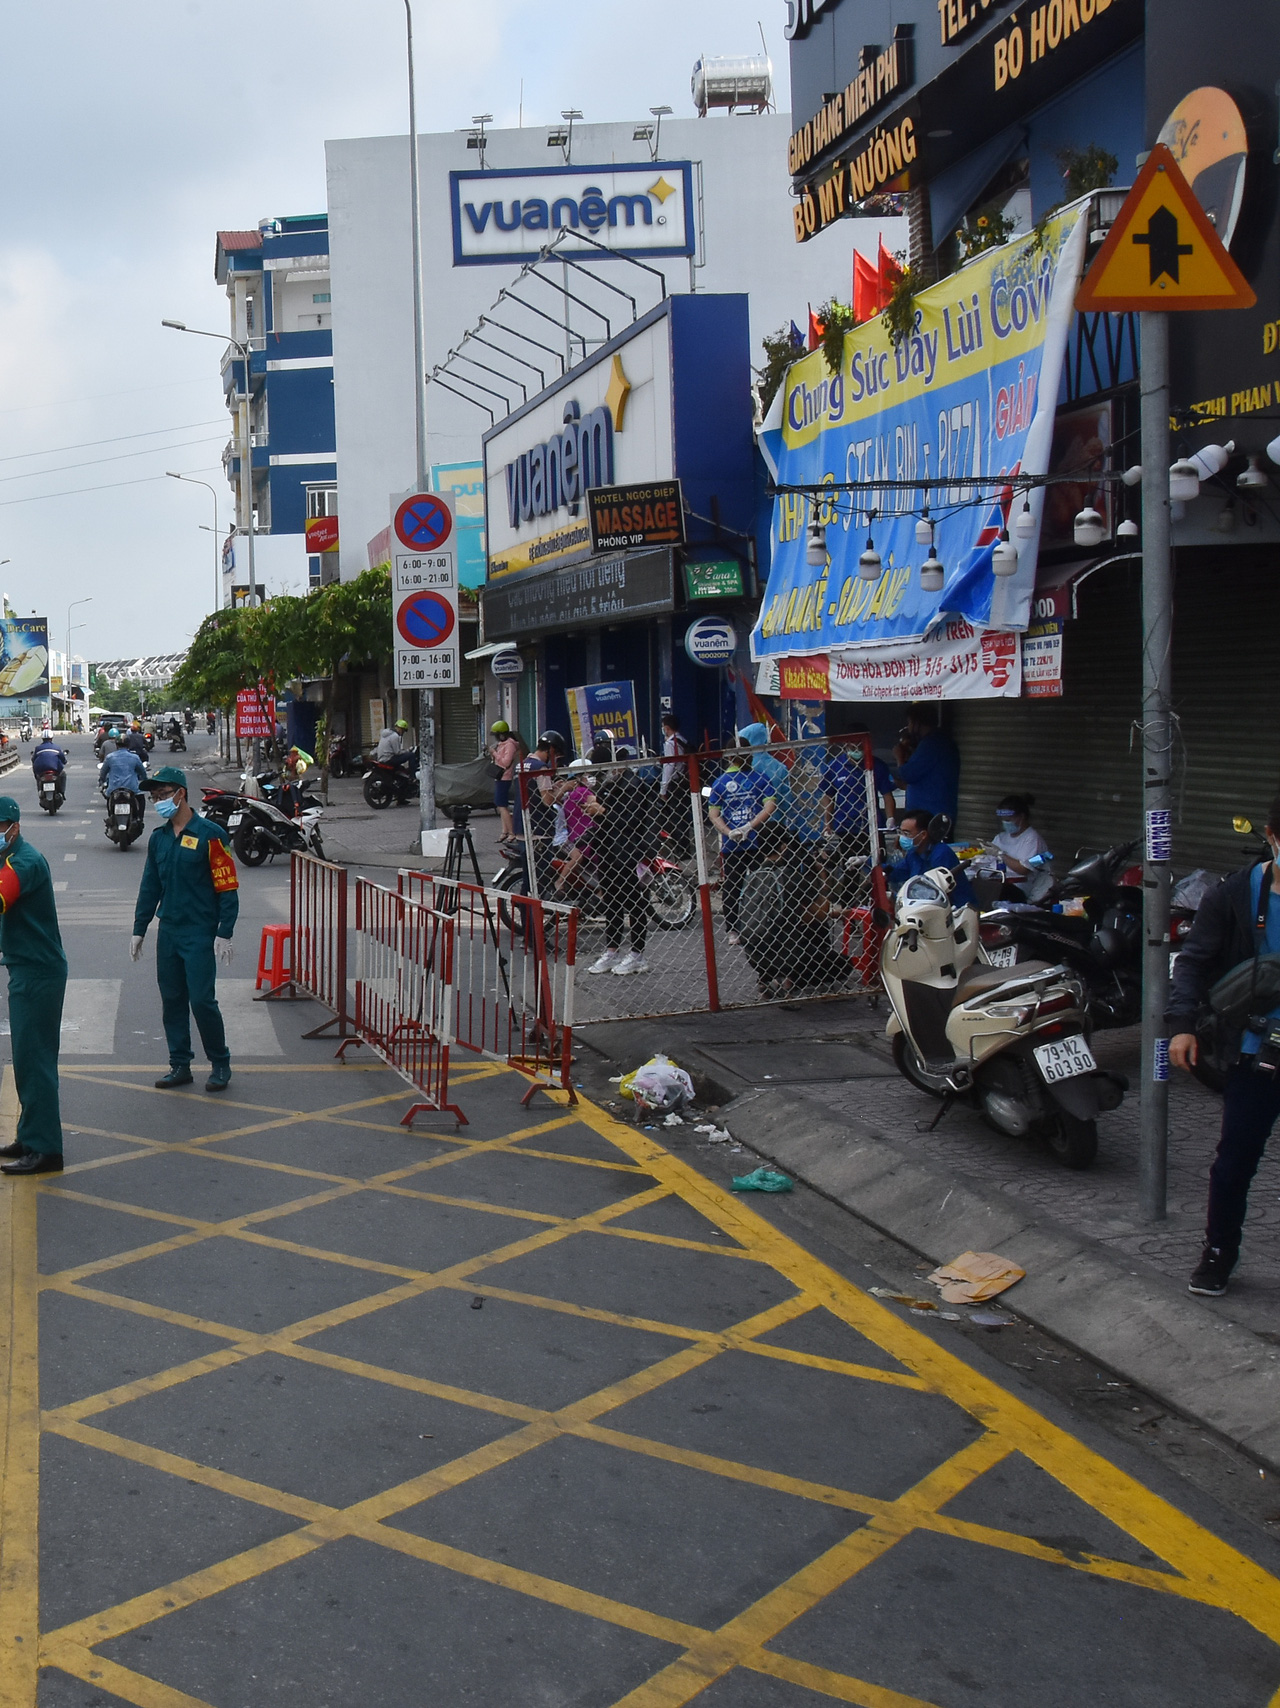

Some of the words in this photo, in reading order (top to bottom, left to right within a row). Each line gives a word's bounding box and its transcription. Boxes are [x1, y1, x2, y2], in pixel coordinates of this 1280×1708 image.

[994, 14, 1023, 92] BÒ
[788, 121, 811, 176] GIAO
[813, 93, 843, 155] HÀNG
[845, 48, 875, 129] MIỄN
[877, 24, 899, 101] PHÍ
[792, 184, 817, 243] BÒ
[818, 160, 845, 225] MỸ
[850, 116, 917, 201] NƯỚNG
[788, 375, 845, 431] Chung
[851, 346, 890, 402] Sức
[942, 292, 983, 362] Lùi
[1231, 384, 1271, 416] PHAN
[594, 494, 623, 505] HOTEL
[626, 491, 651, 503] NGỌC
[654, 487, 675, 500] ĐIỆP
[596, 502, 678, 535] MASSAGE
[598, 535, 628, 548] PHÒNG
[630, 534, 643, 544] VIP
[6, 623, 46, 633] Dr.Care
[402, 654, 419, 666] 9:00
[429, 653, 451, 664] 16:00
[837, 655, 860, 679] TỔNG
[862, 657, 882, 679] HÓA
[885, 660, 906, 678] ĐƠN
[403, 669, 424, 680] 21:00
[434, 669, 451, 679] 6:00
[592, 713, 623, 727] MUA
[623, 710, 634, 738] 1
[1042, 1040, 1081, 1063] 79-N2
[1046, 1053, 1092, 1080] 603.90
